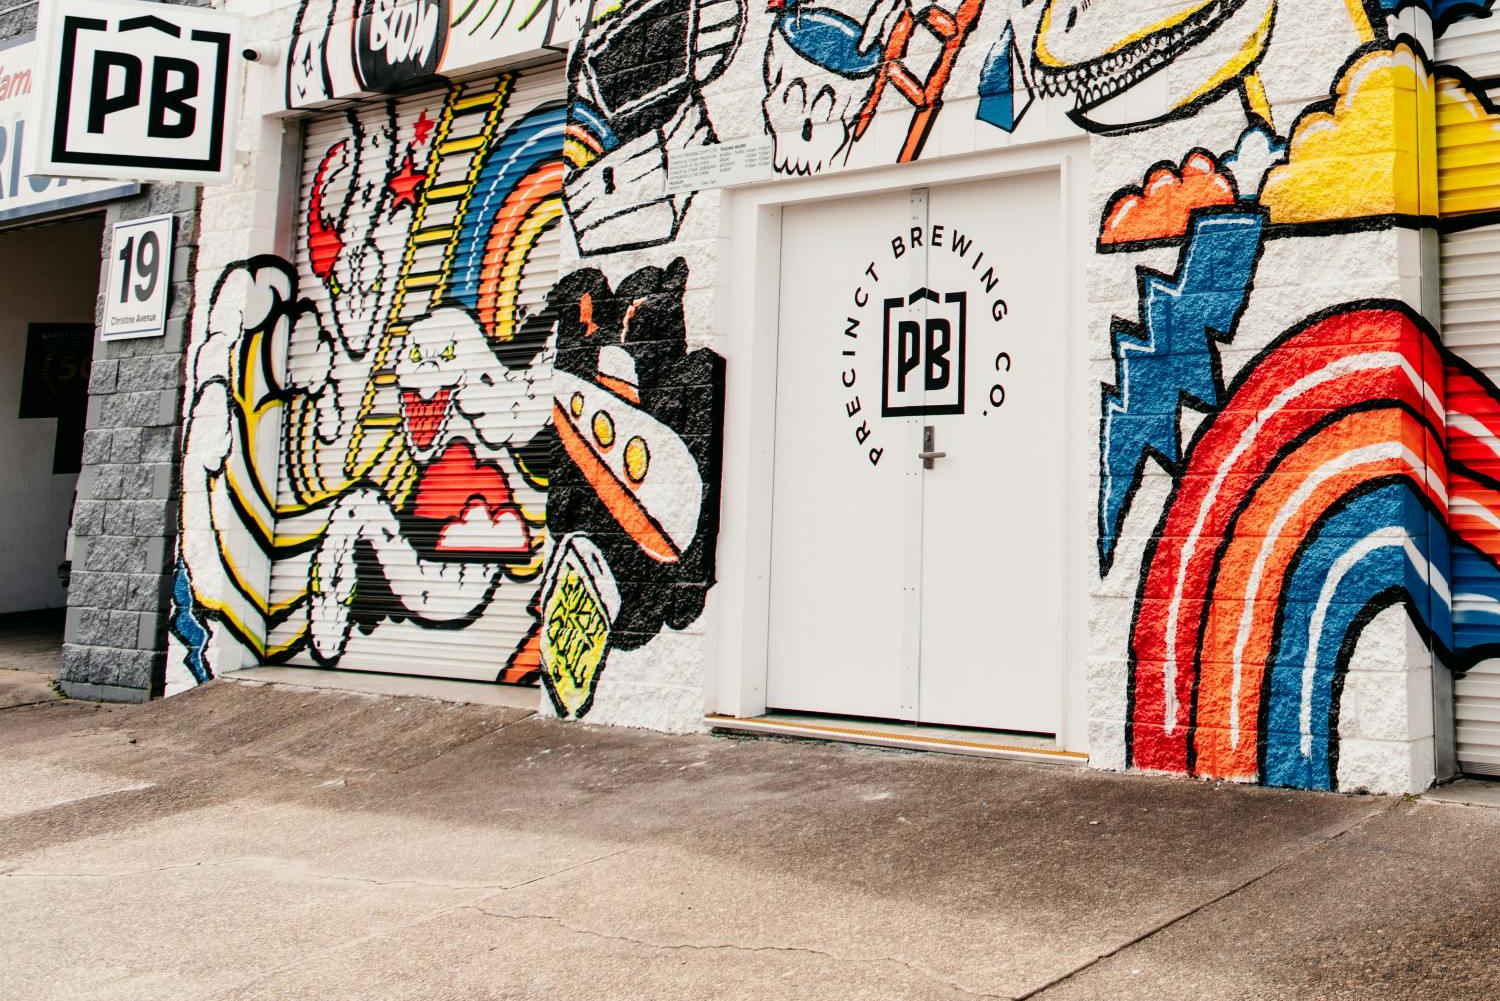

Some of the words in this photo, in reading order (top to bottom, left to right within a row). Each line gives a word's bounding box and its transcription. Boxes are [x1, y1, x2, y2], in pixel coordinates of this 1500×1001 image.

[87, 49, 200, 139] PB
[119, 230, 160, 304] 19
[111, 316, 135, 326] Christine
[136, 314, 156, 323] Avenue
[842, 262, 884, 466] PRECINCT
[891, 225, 1008, 322] BREWING
[983, 352, 1011, 416] CO.
[897, 318, 951, 393] PB
